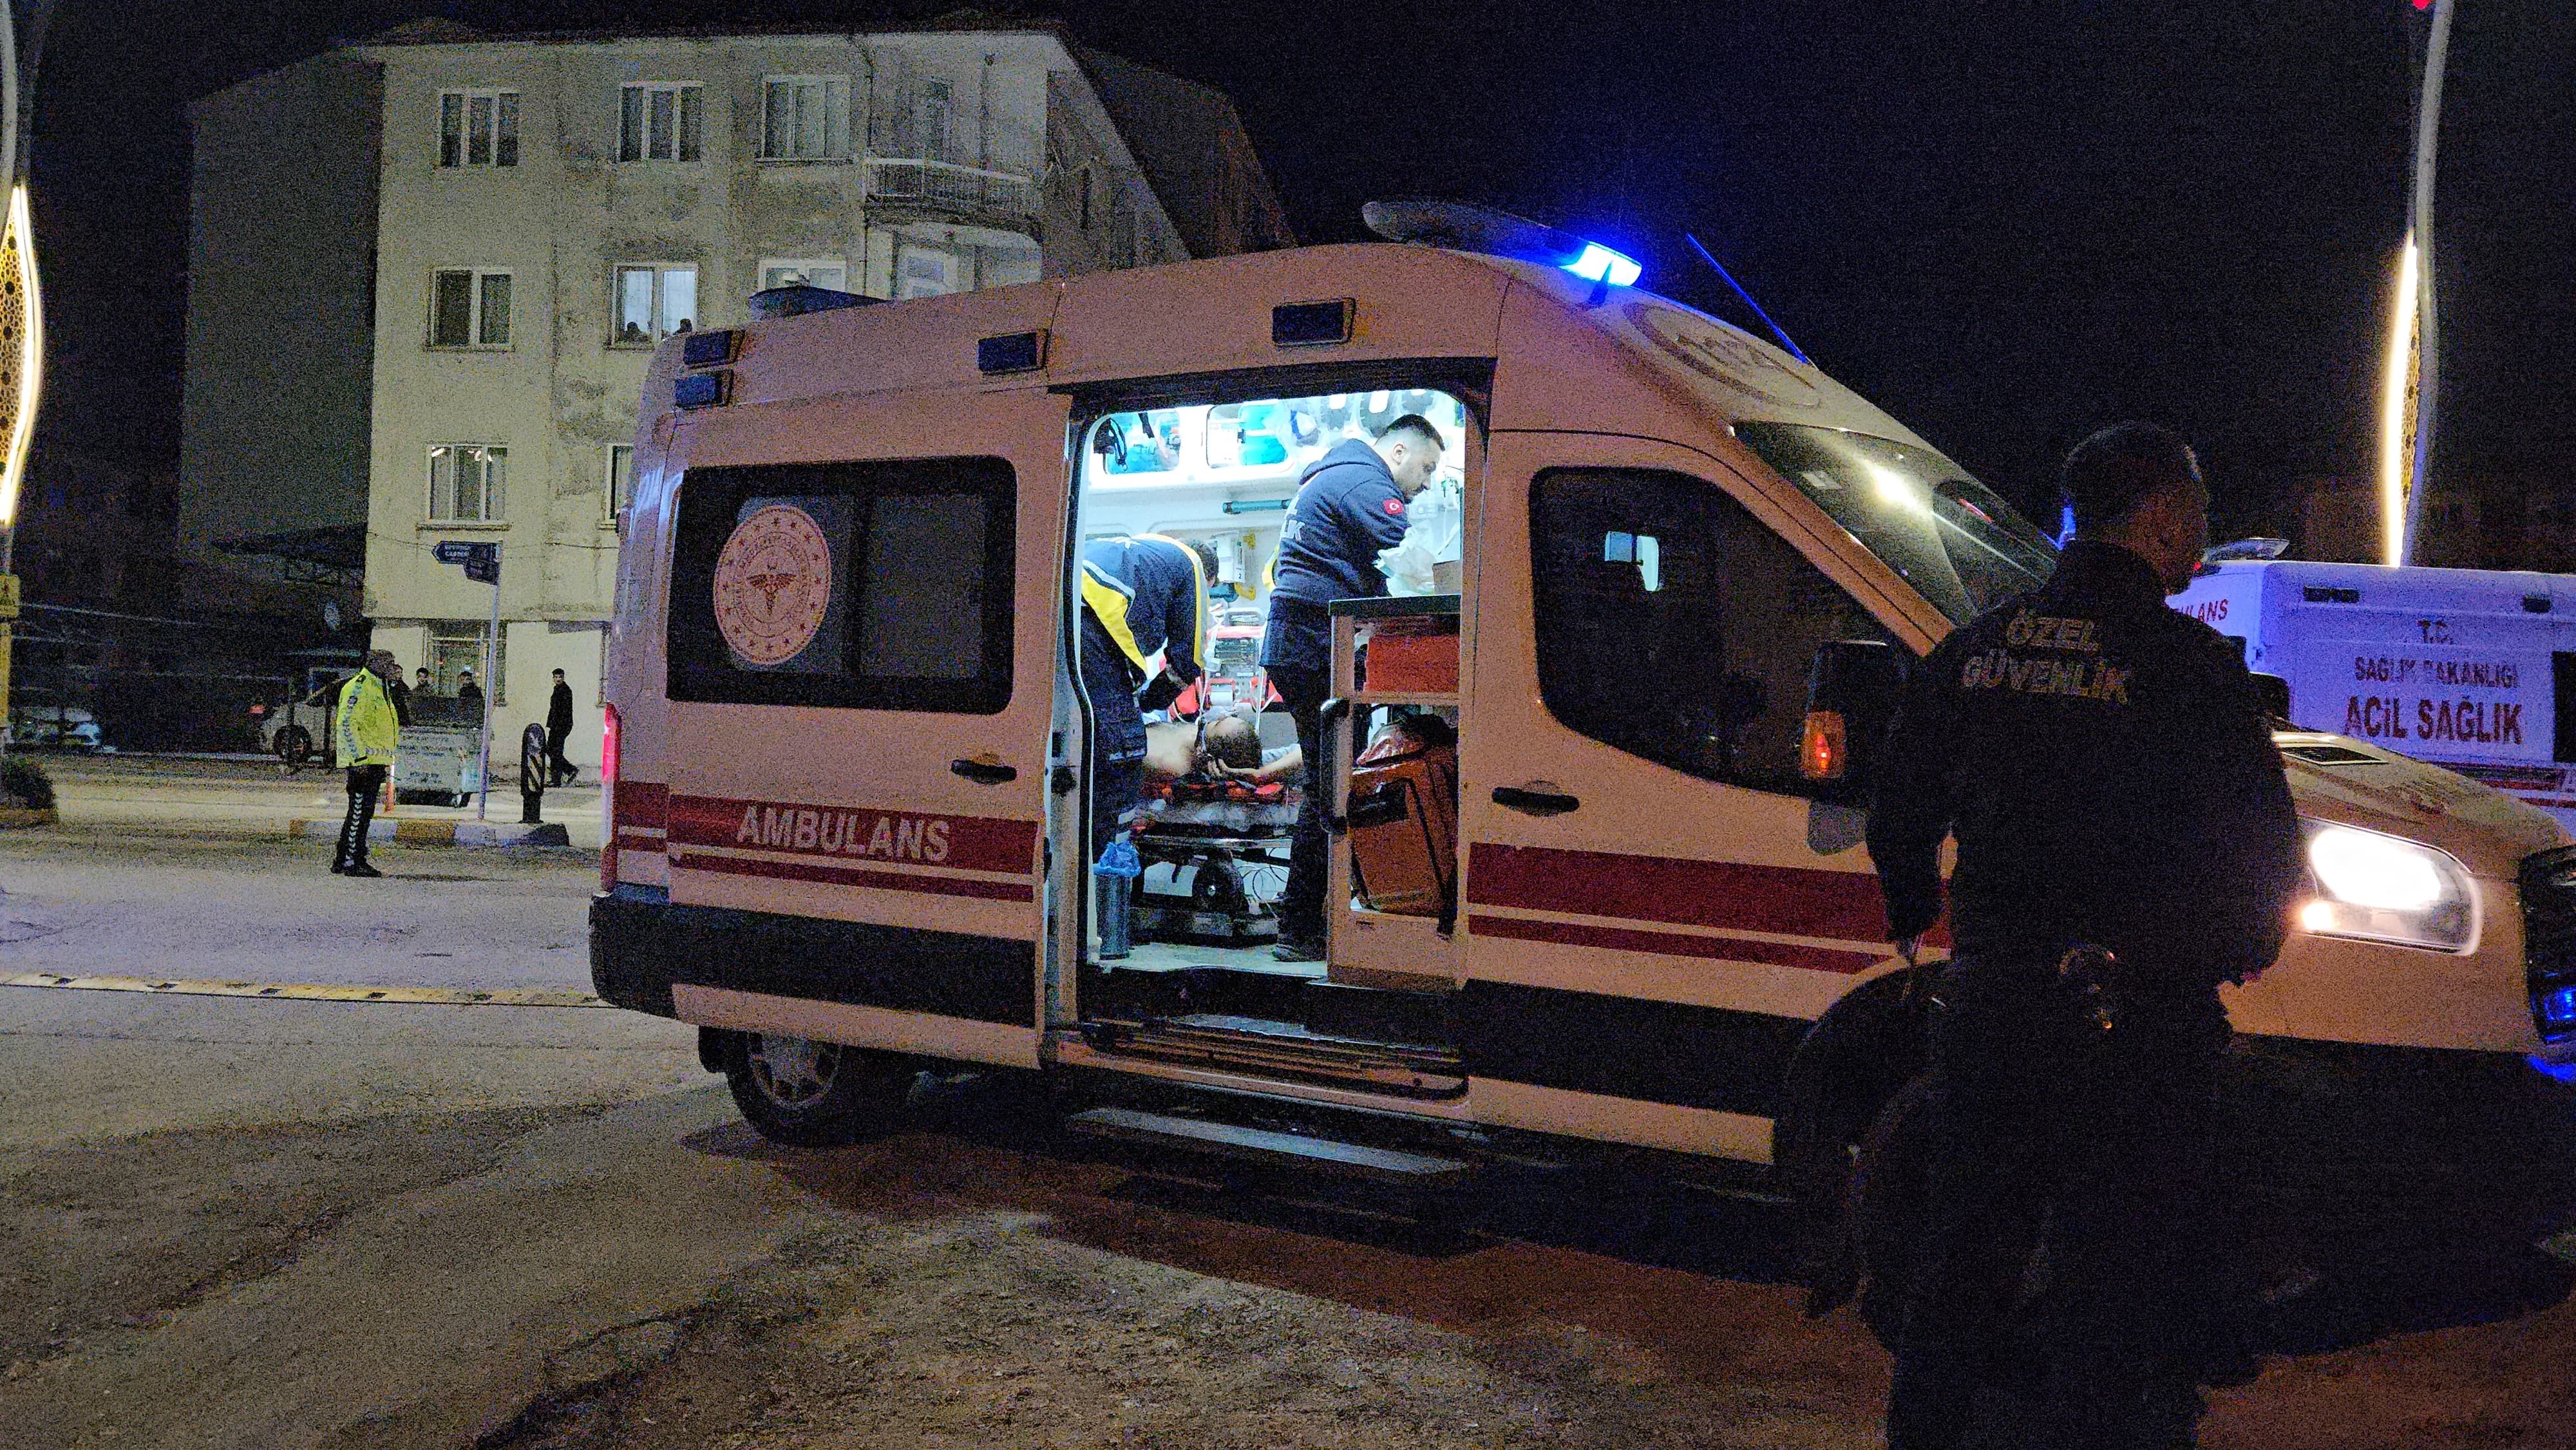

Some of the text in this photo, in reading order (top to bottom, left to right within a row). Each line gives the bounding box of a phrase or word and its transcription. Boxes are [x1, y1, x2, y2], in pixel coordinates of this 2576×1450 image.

[2006, 608, 2102, 653] ÖZEL
[2417, 619, 2454, 645] T.C.
[2344, 695, 2522, 744] ACİL SAĞLIK
[737, 804, 950, 862] AMBULANS
